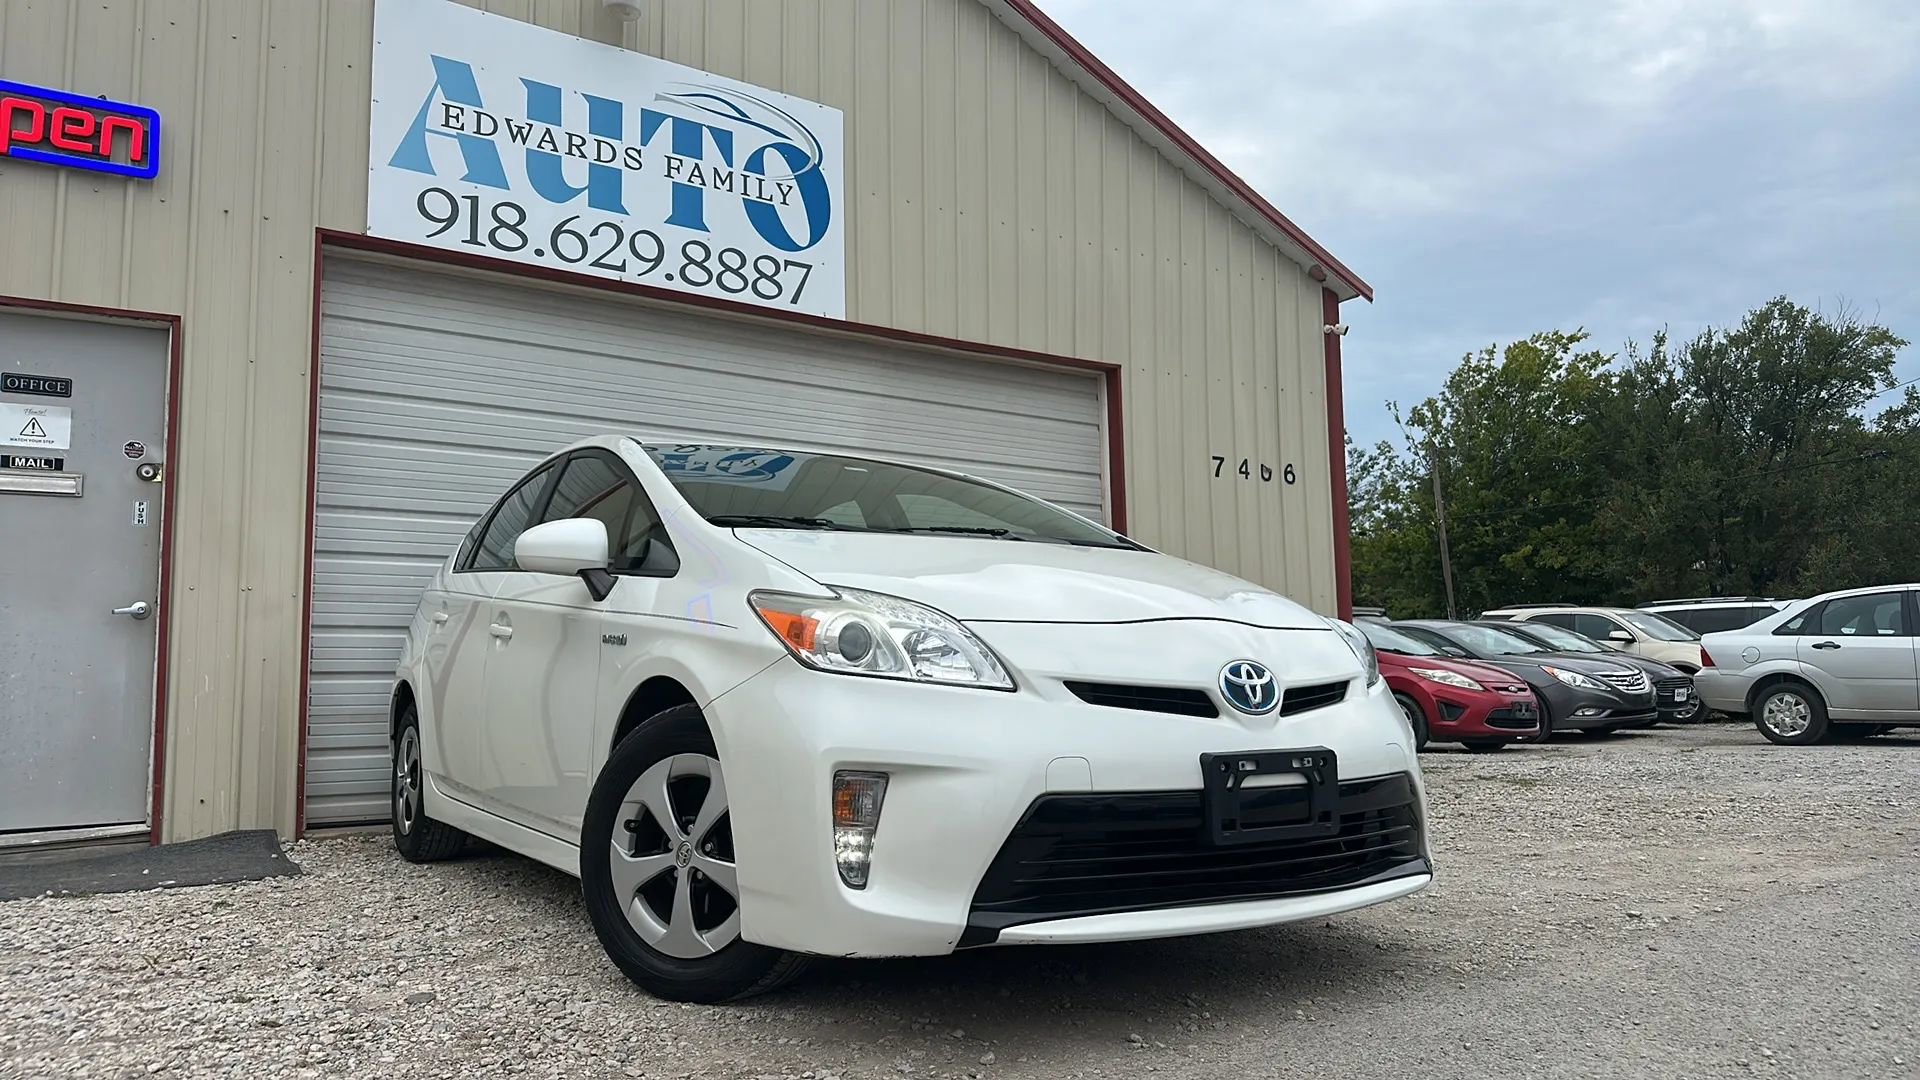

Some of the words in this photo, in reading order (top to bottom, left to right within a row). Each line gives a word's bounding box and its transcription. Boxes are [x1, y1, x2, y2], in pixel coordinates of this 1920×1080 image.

[388, 54, 832, 252] AUTO
[440, 102, 643, 171] EDWARDS
[663, 154, 795, 206] FAMILY
[416, 187, 813, 304] 918.629.8887
[7, 377, 66, 392] OFFICE
[15, 457, 49, 468] MAIL
